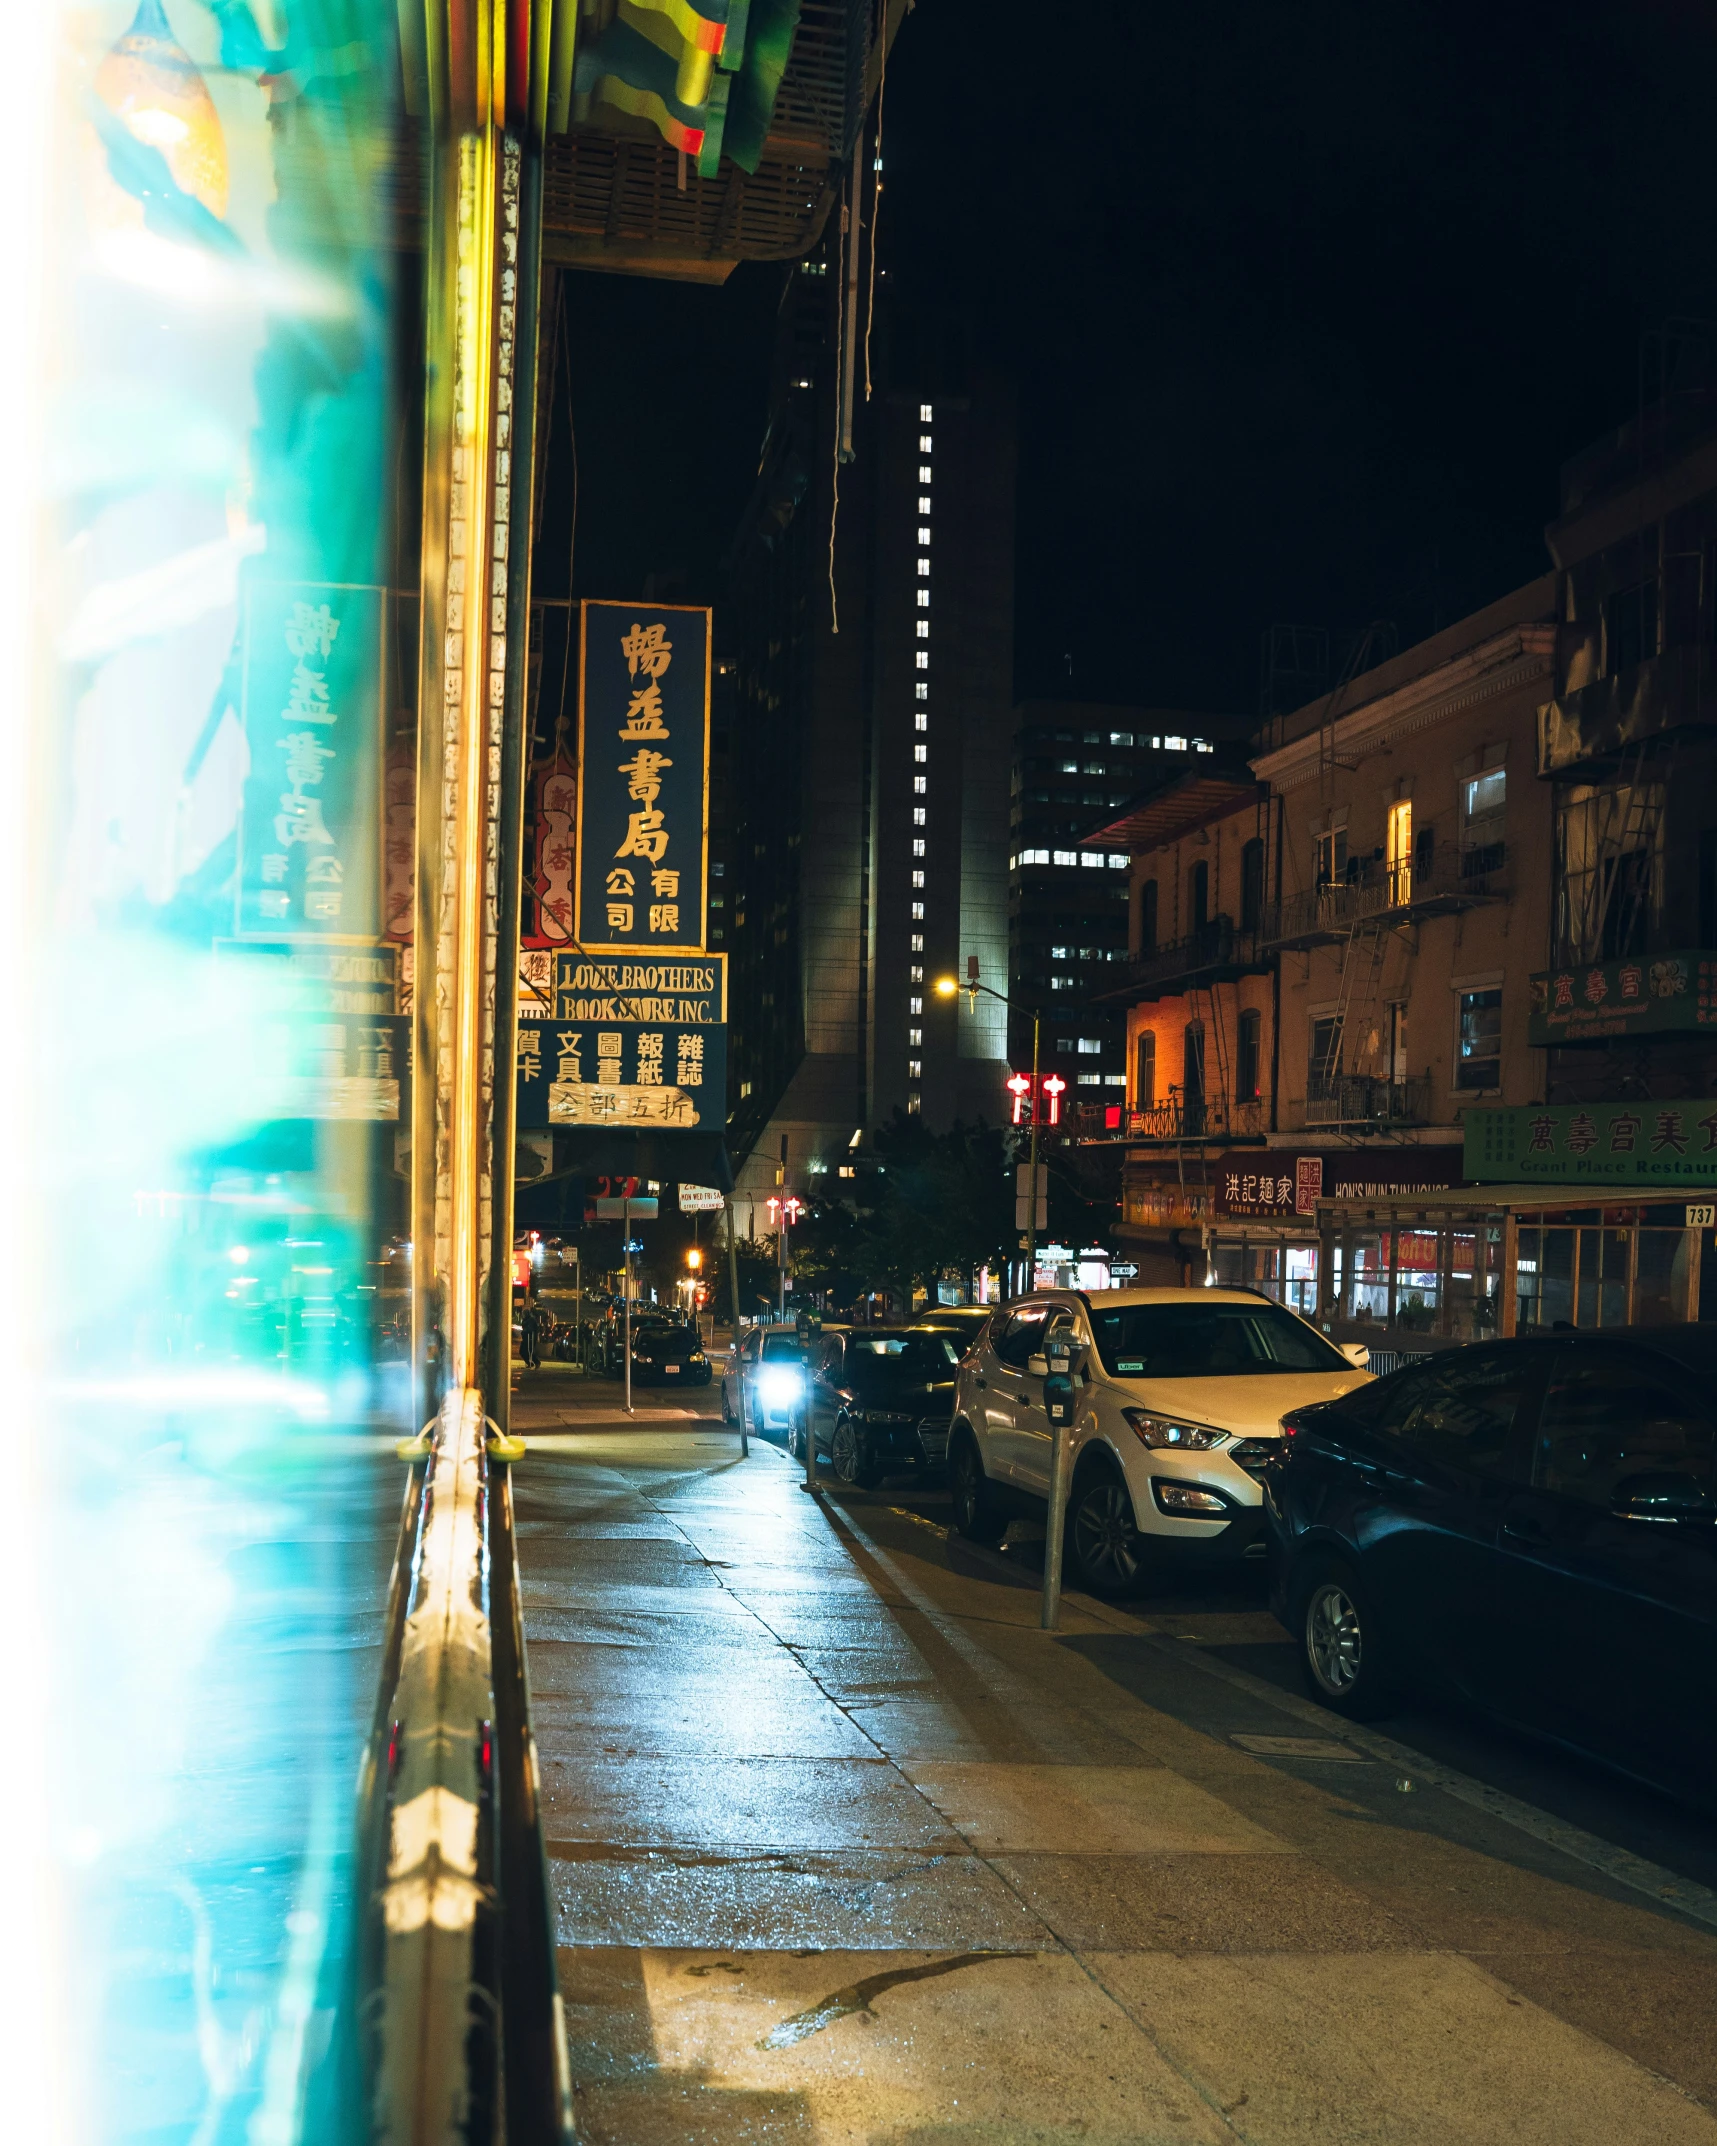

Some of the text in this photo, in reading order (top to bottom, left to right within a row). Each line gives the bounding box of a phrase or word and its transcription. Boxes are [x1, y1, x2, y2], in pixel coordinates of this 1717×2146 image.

[613, 622, 673, 866] 暢益書局
[558, 963, 619, 992] LOUIE
[620, 965, 715, 993] BROTHERS
[677, 999, 713, 1022] INC.
[556, 1030, 583, 1084] 文具
[596, 1032, 623, 1085] 圖書
[636, 1032, 664, 1086] 報紙
[676, 1033, 705, 1087] 雜誌
[554, 1091, 689, 1124] 全部五折
[1520, 1160, 1567, 1174] Grant
[1577, 1160, 1626, 1174] Place
[1225, 1172, 1293, 1205] 洪記麵家
[1335, 1182, 1363, 1198] HON'S
[1365, 1182, 1387, 1197] WUN
[1183, 1196, 1215, 1216] MART
[1690, 1208, 1711, 1224] 737
